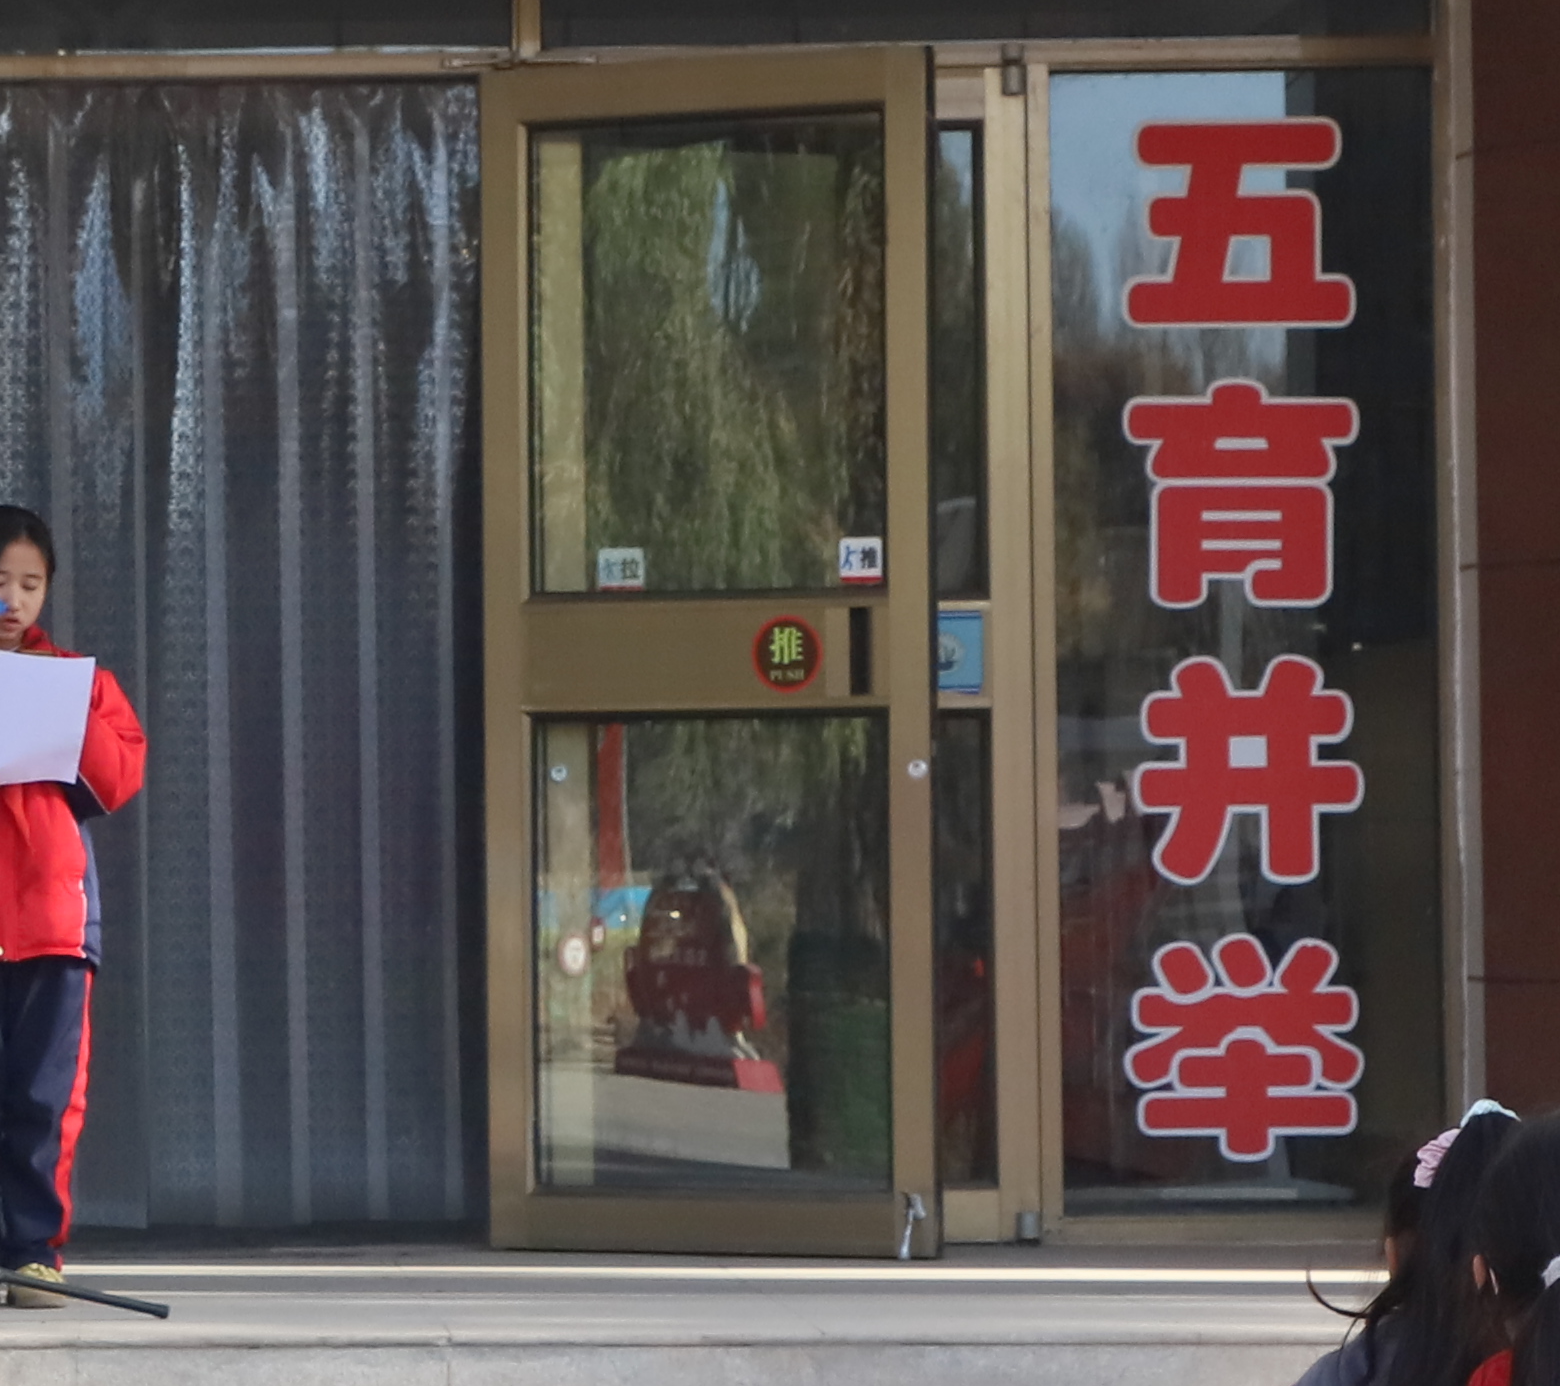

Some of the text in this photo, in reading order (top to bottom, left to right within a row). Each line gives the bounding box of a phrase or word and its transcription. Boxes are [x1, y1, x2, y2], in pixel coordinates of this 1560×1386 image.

[859, 546, 878, 569] 推
[620, 558, 642, 581] 拉
[769, 626, 804, 664] 推
[1122, 116, 1365, 1163] 五育并举
[770, 669, 805, 682] PUSH
